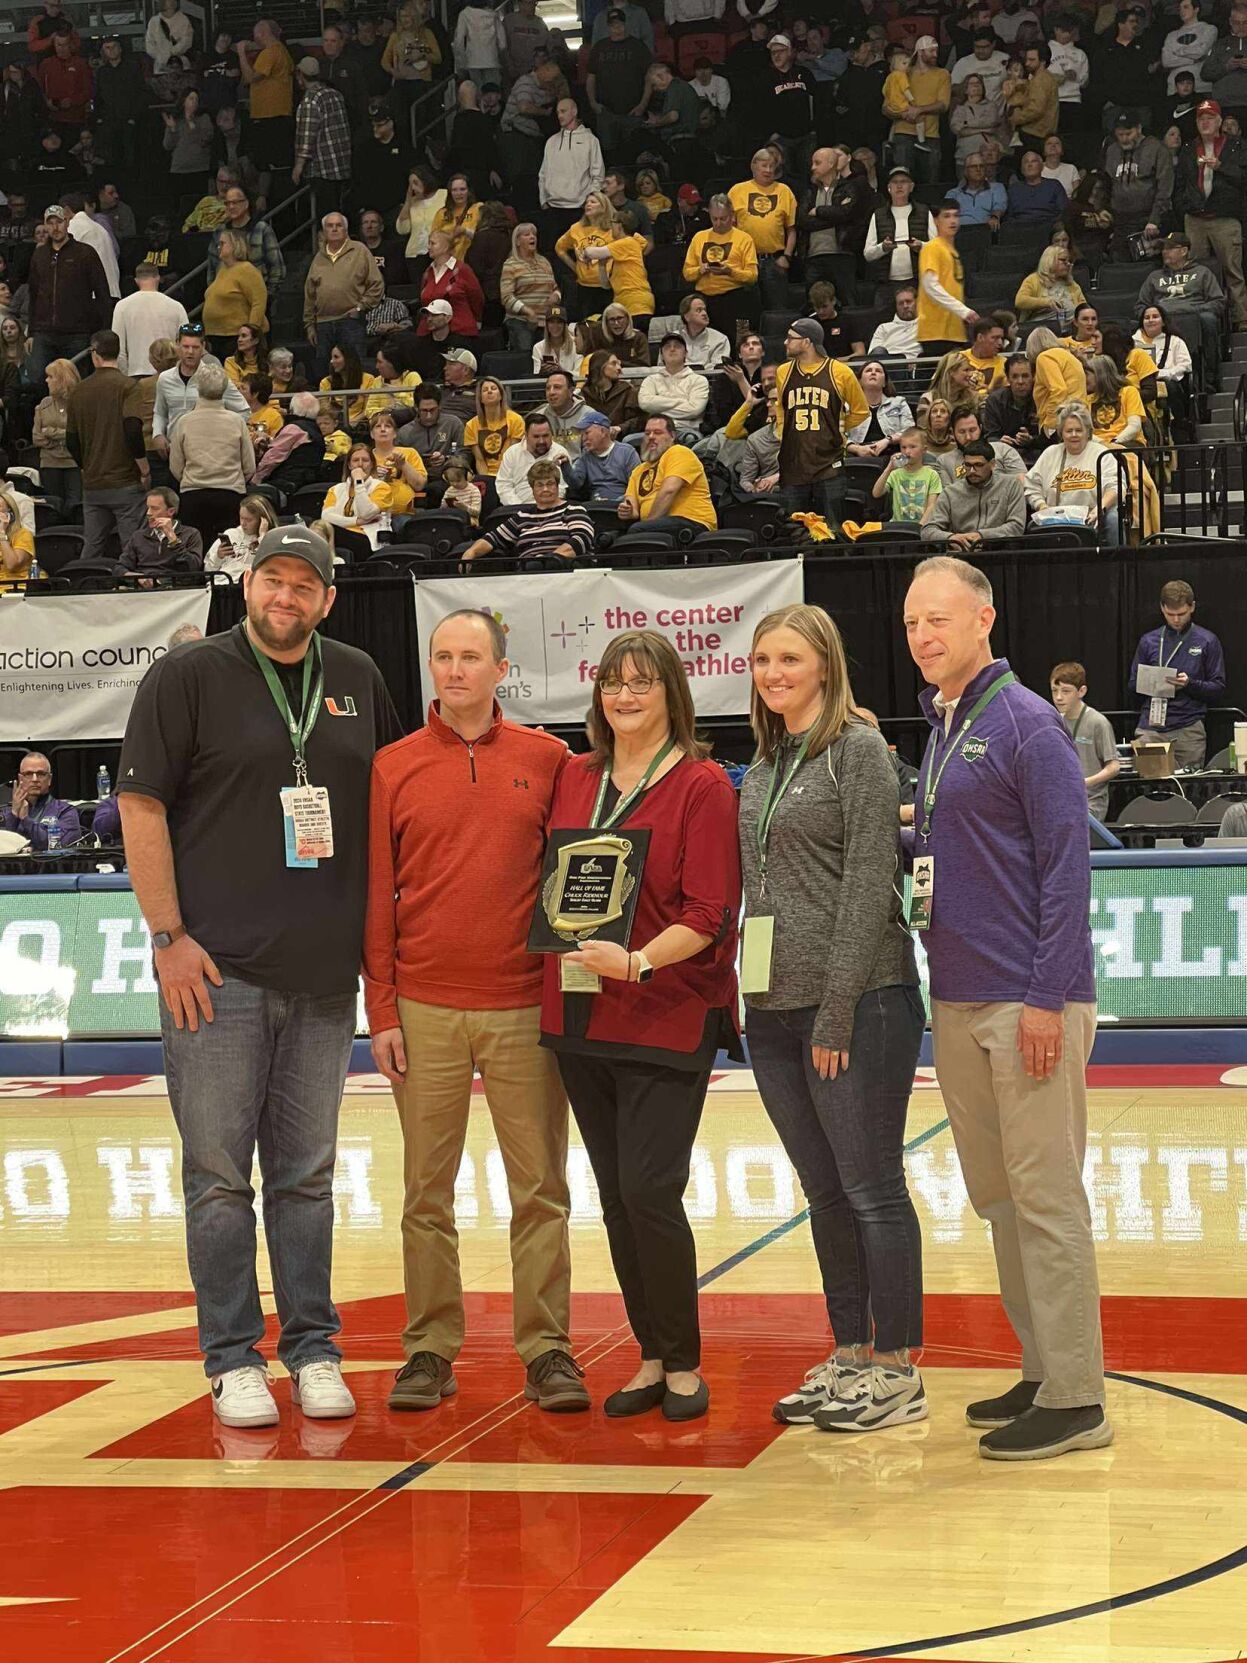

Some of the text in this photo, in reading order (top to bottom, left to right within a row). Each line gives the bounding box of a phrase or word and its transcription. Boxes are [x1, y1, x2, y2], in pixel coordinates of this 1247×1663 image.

[787, 386, 830, 410] ALTER
[795, 408, 821, 431] 51
[604, 604, 745, 630] the center
[675, 629, 722, 653] the
[1, 682, 65, 694] Enlightening
[67, 681, 95, 691] Lives.
[324, 696, 358, 716] U
